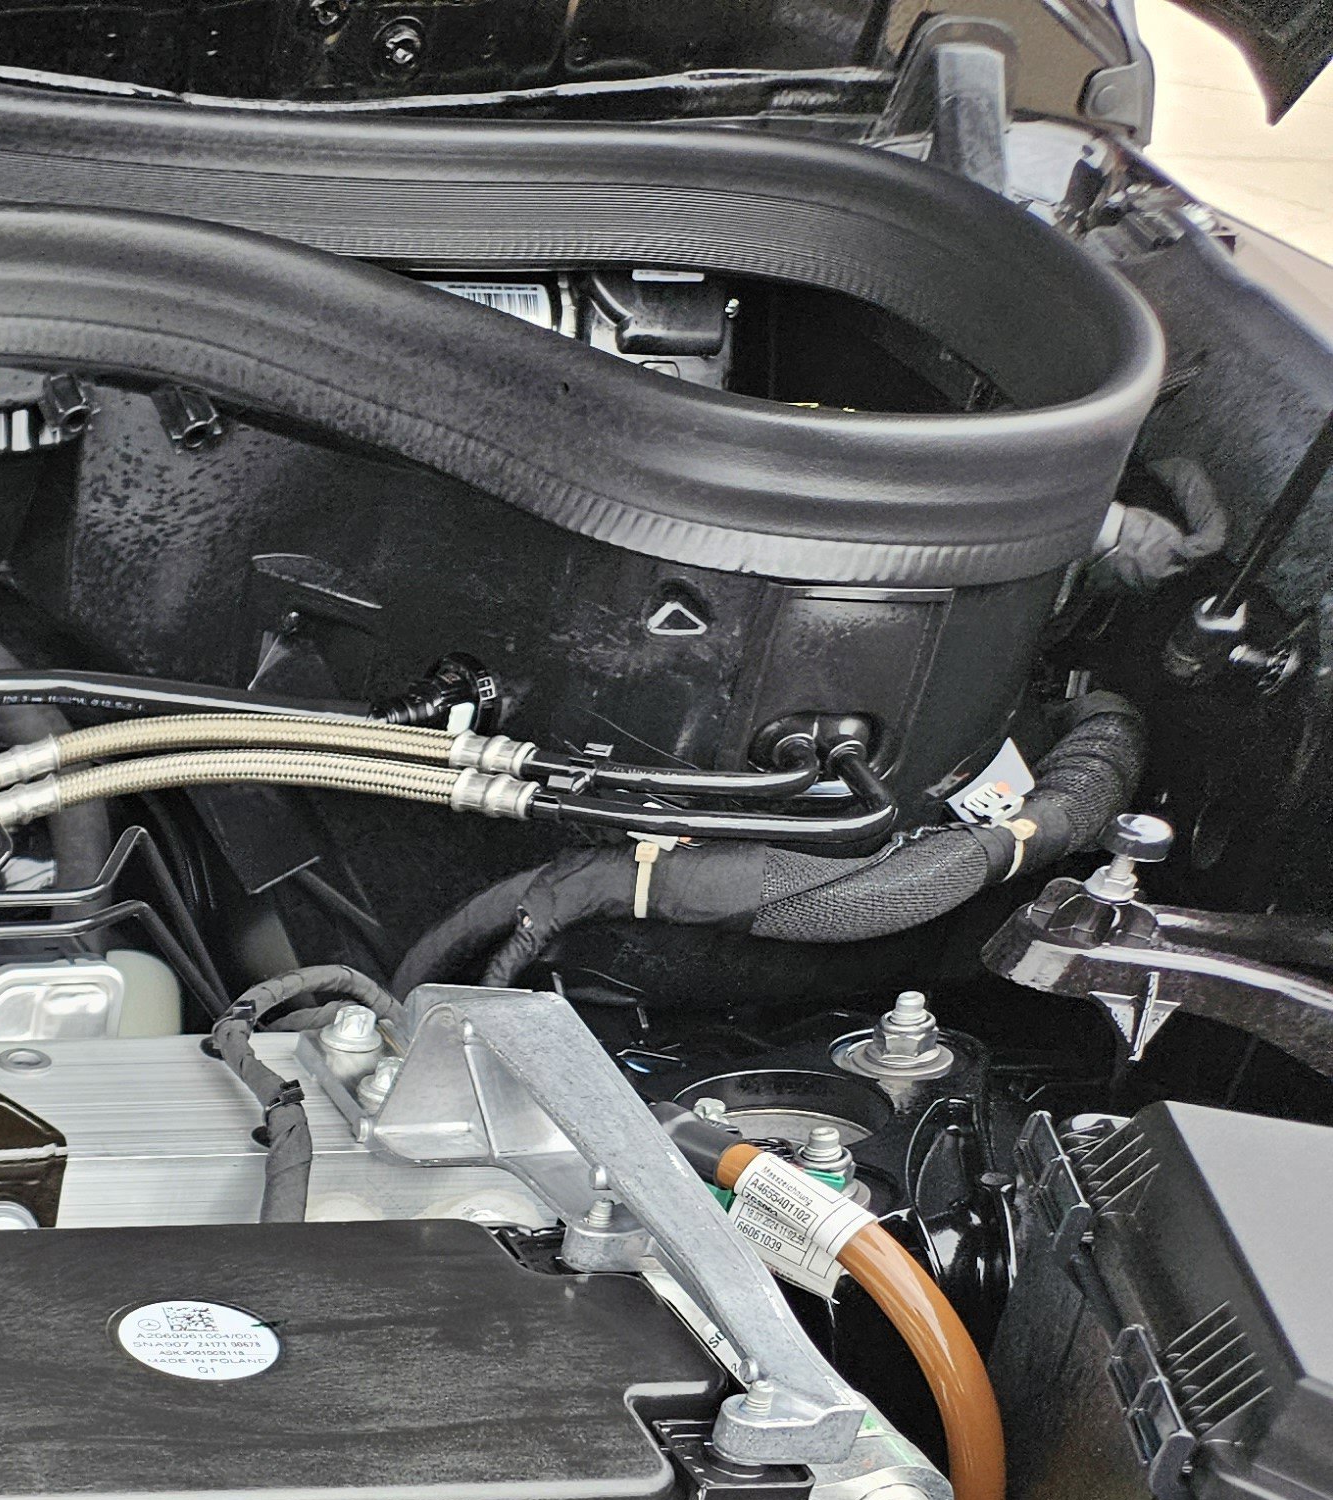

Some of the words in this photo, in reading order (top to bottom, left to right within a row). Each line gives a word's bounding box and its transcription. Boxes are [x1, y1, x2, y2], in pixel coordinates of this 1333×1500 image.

[750, 1178, 811, 1224] A4655401102
[761, 1166, 813, 1206] Masszeichnung
[736, 1221, 782, 1251] 66061039
